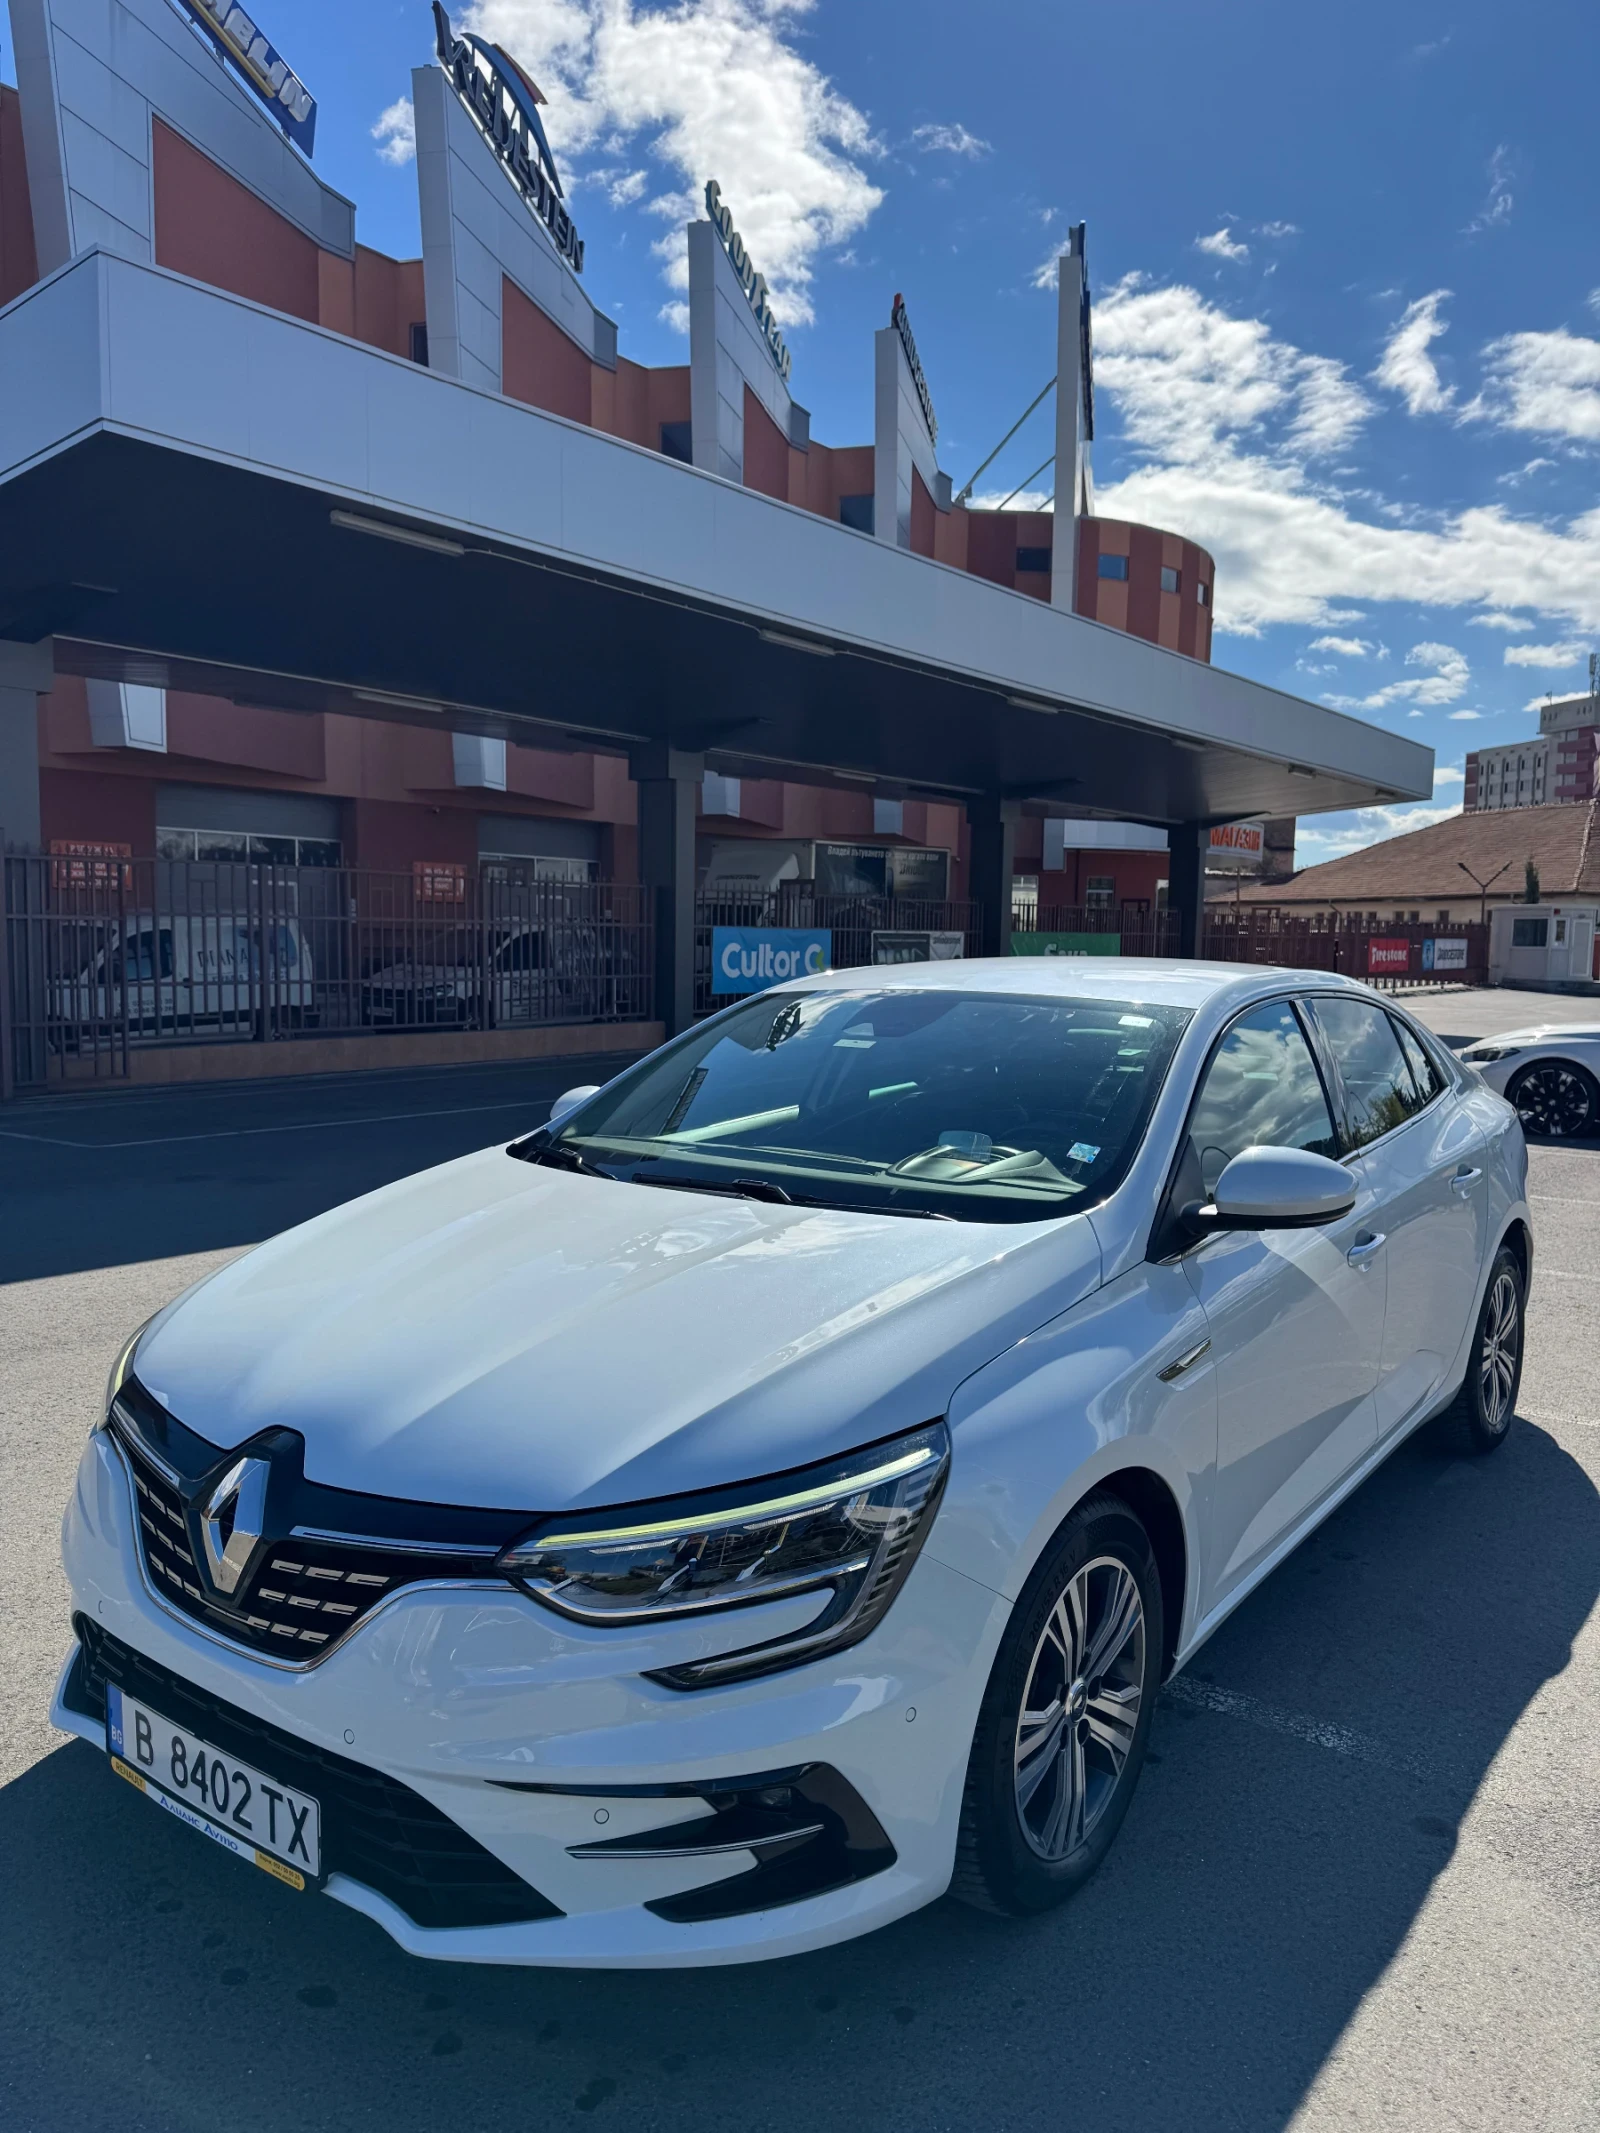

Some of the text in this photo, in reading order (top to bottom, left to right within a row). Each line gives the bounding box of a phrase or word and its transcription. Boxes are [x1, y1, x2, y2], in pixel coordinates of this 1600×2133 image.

[432, 0, 584, 274] VREDESTEIN
[1210, 825, 1261, 851] МАГАЗИН
[721, 942, 801, 979] Cultor
[1372, 946, 1407, 965] Firestone
[111, 1724, 123, 1745] BG
[134, 1709, 154, 1767] B
[115, 1761, 144, 1788] RENAULT
